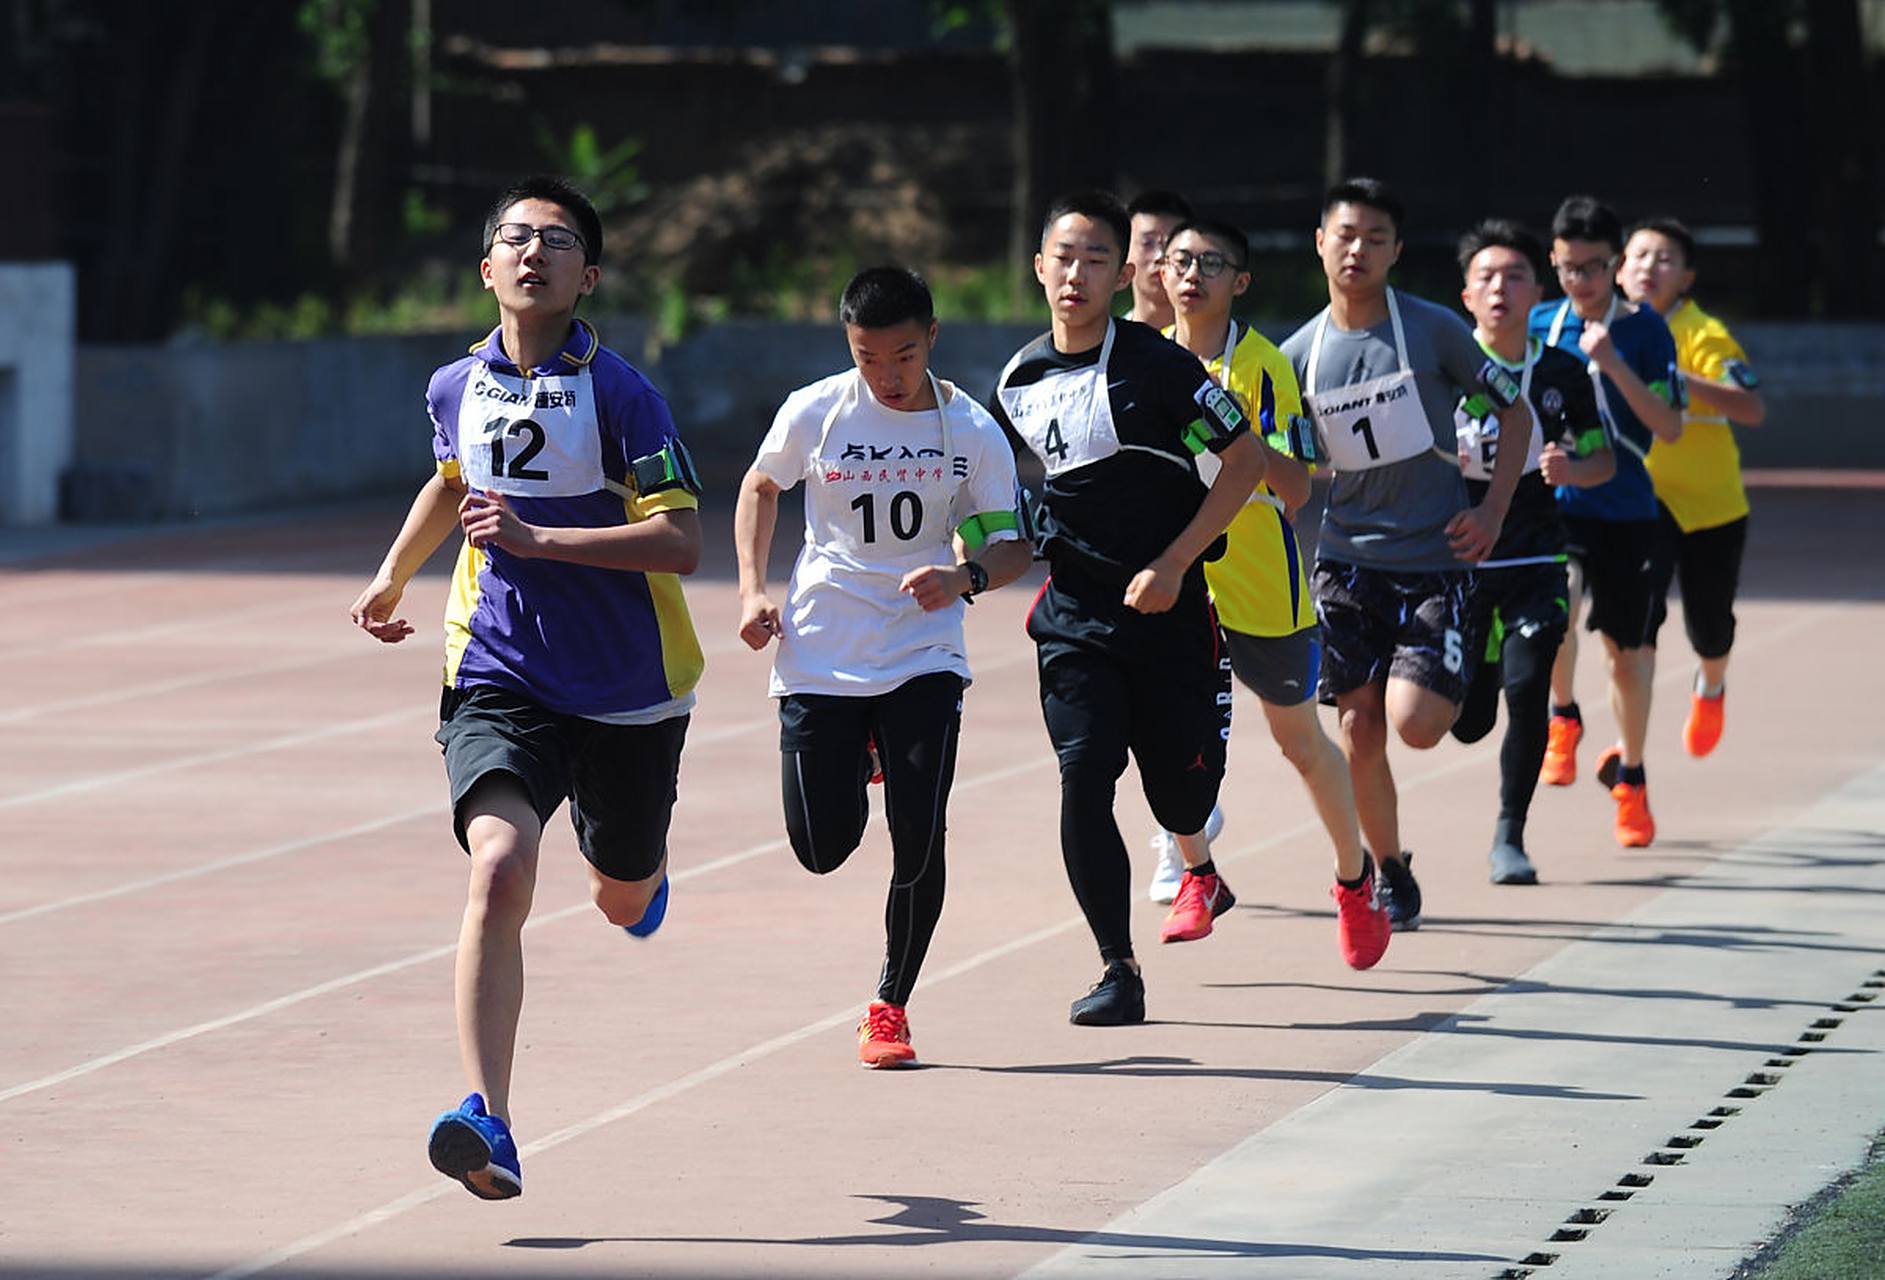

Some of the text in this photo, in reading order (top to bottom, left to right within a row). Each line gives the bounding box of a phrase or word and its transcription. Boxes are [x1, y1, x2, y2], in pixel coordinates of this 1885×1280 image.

[483, 416, 549, 482] 12
[1045, 418, 1069, 461] 4
[1352, 416, 1381, 461] 1
[851, 490, 924, 544] 10
